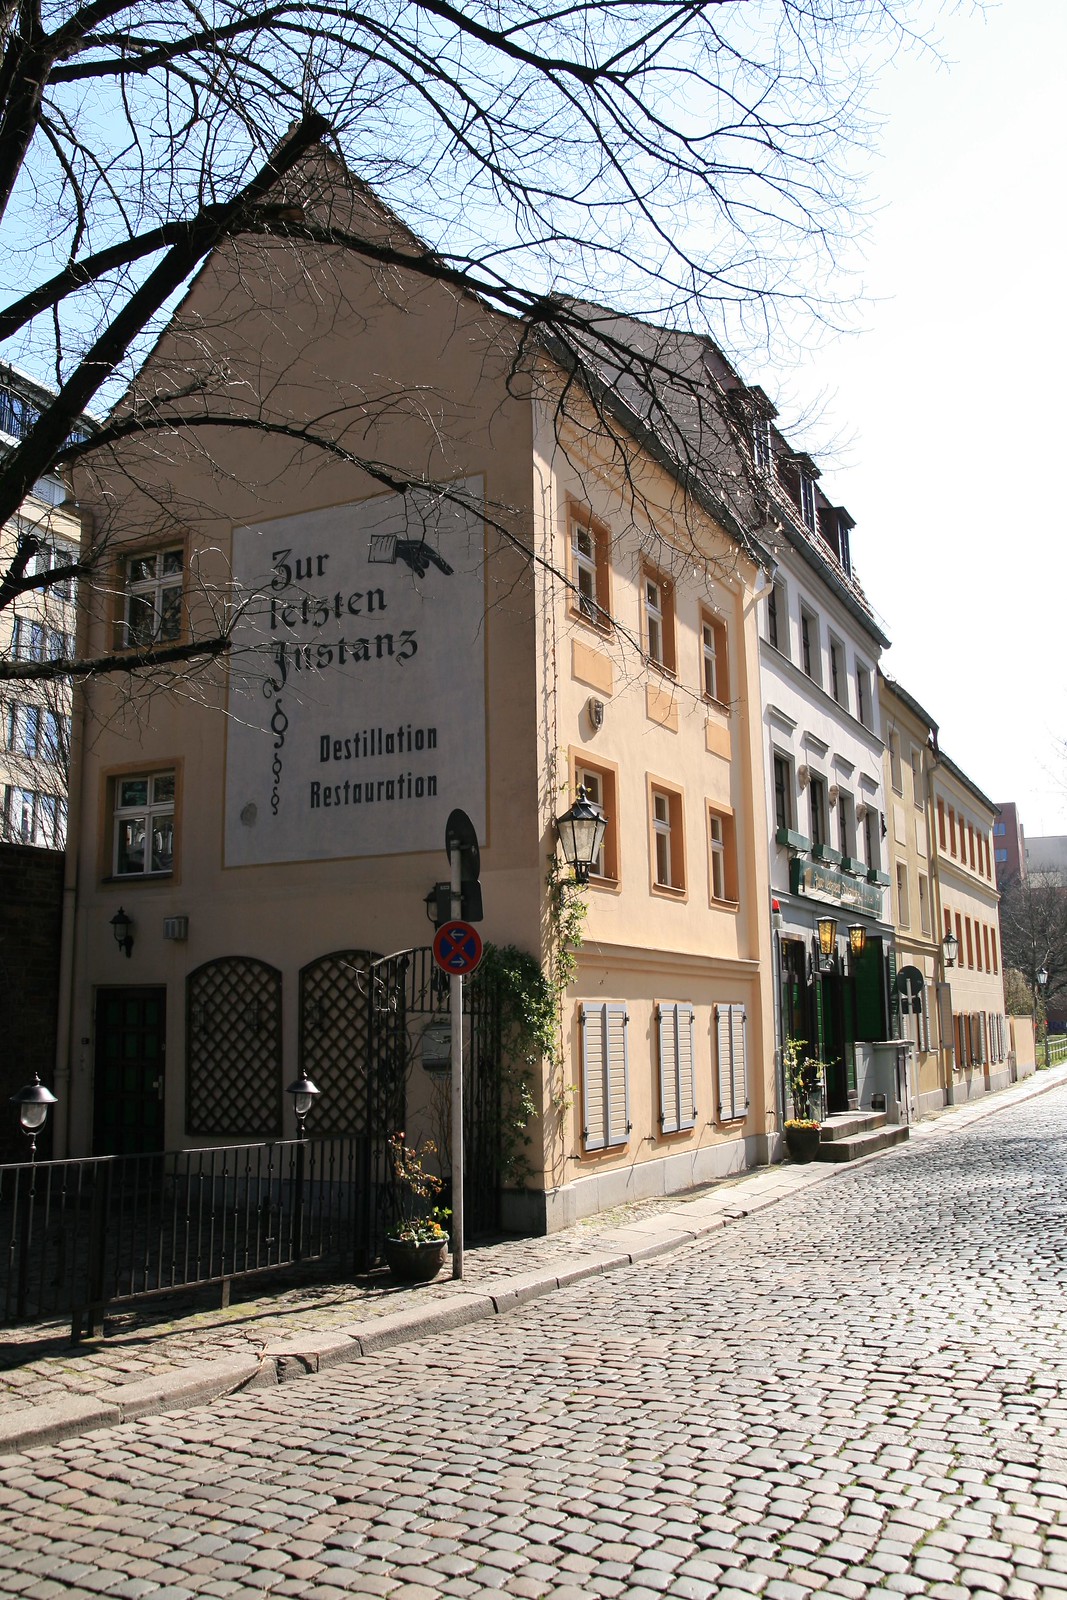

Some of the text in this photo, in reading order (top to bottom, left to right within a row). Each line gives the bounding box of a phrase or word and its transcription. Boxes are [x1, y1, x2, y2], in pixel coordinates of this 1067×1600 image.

[271, 549, 330, 591] Zur
[270, 588, 388, 630] letzten
[320, 724, 437, 762] Destillation
[310, 772, 438, 808] Restauration
